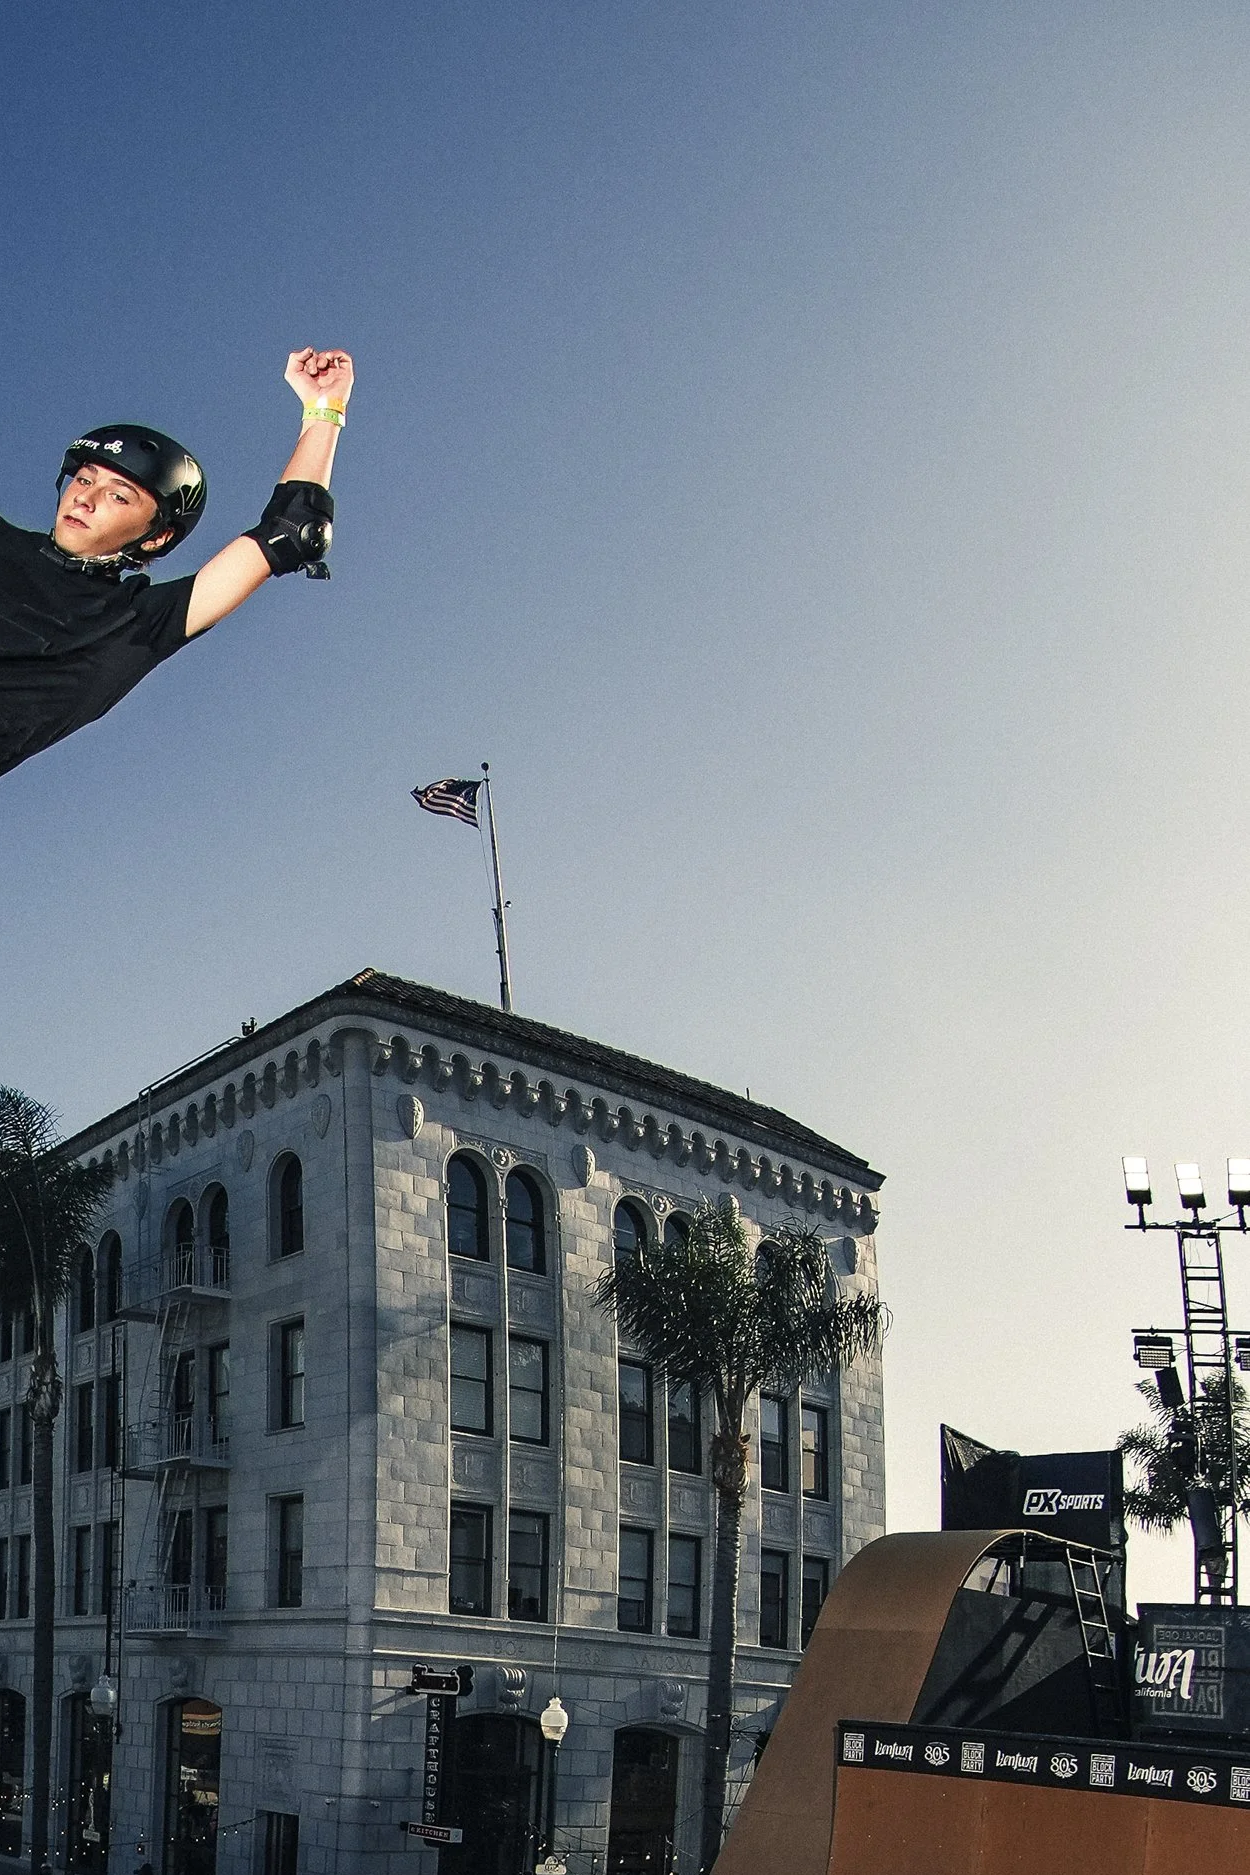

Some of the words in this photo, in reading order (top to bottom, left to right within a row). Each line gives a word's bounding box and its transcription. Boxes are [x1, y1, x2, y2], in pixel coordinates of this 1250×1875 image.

[1058, 1494, 1105, 1510] SPORTS
[1134, 1640, 1195, 1700] tura
[1134, 1687, 1172, 1698] alifornia
[845, 1740, 863, 1750] BLOCK
[425, 1698, 441, 1823] CRAFTHOUSE
[844, 1751, 863, 1761] PARTY
[924, 1746, 950, 1763] 805
[963, 1750, 983, 1760] BLOCK
[963, 1760, 983, 1771] PARTY
[1050, 1756, 1078, 1775] 805
[1092, 1761, 1113, 1773] BLOCK
[1091, 1773, 1113, 1785] PARTY
[1186, 1770, 1217, 1790] 805
[1232, 1774, 1250, 1786] BLOC
[1232, 1787, 1250, 1799] PART
